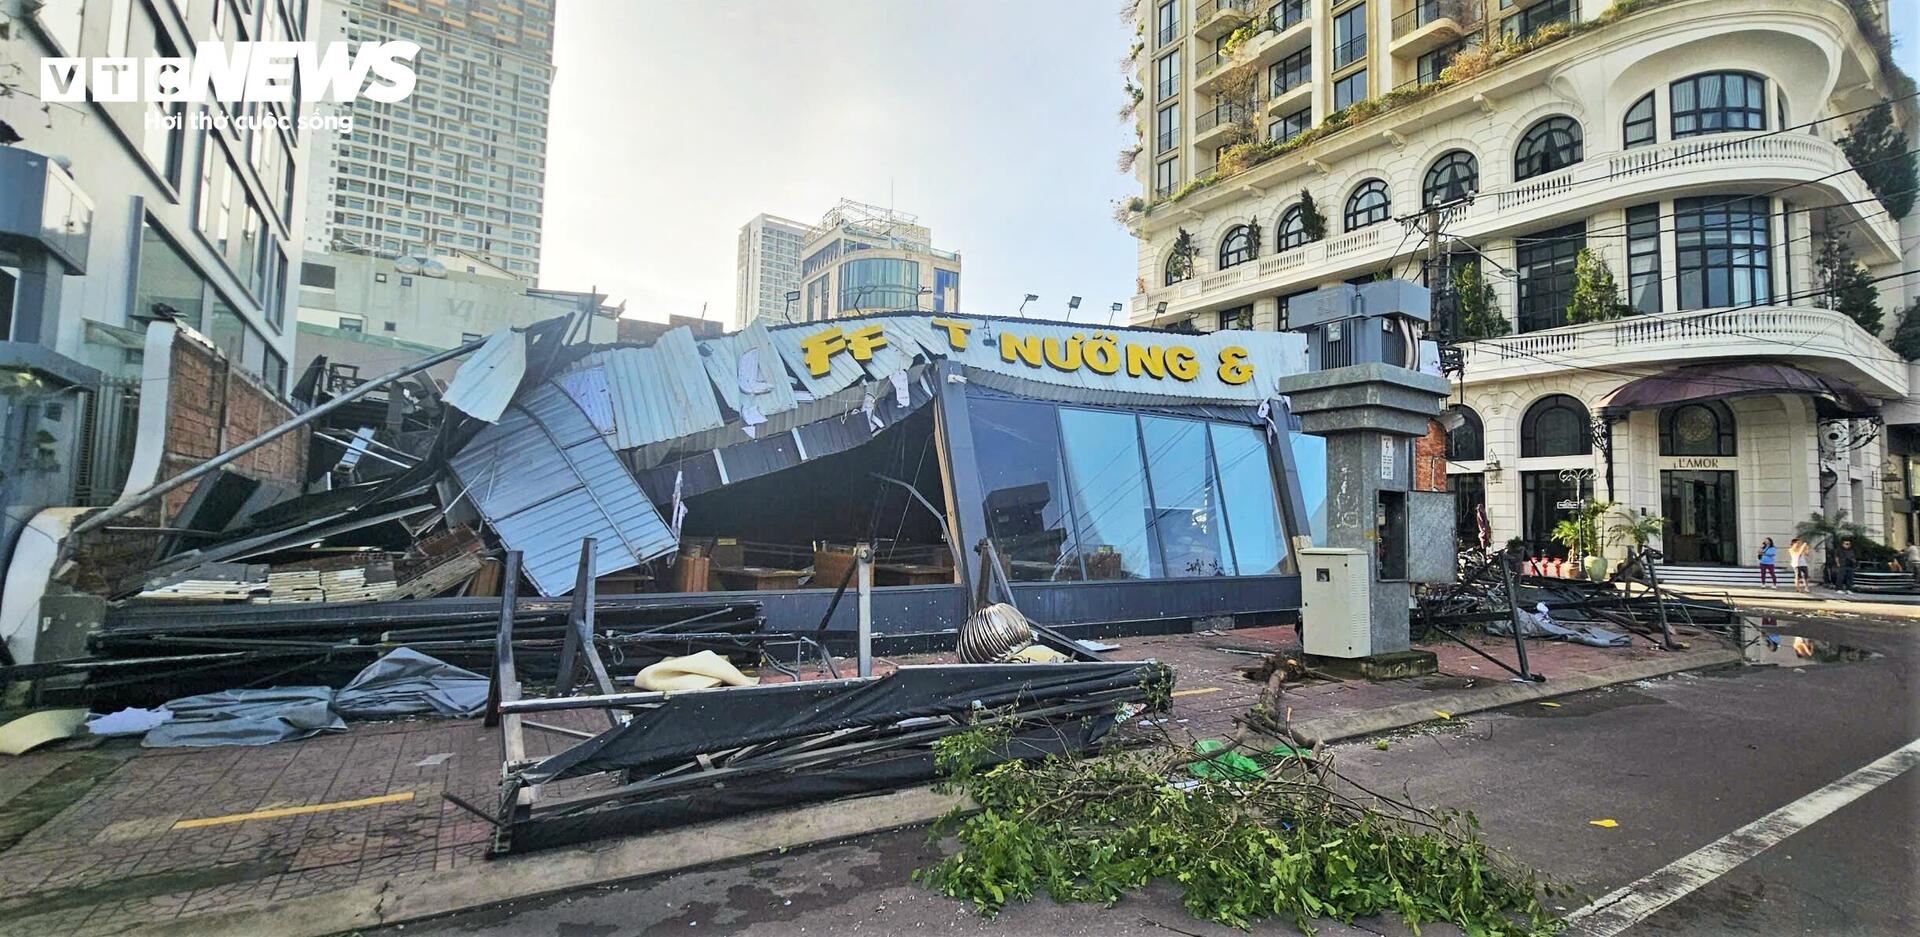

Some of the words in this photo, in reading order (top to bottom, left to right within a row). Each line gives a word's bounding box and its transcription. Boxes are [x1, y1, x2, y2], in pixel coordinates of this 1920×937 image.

[999, 329, 1199, 383] NƯỚNG
[1217, 346, 1255, 385] &
[1679, 458, 1718, 468] L'AMOR
